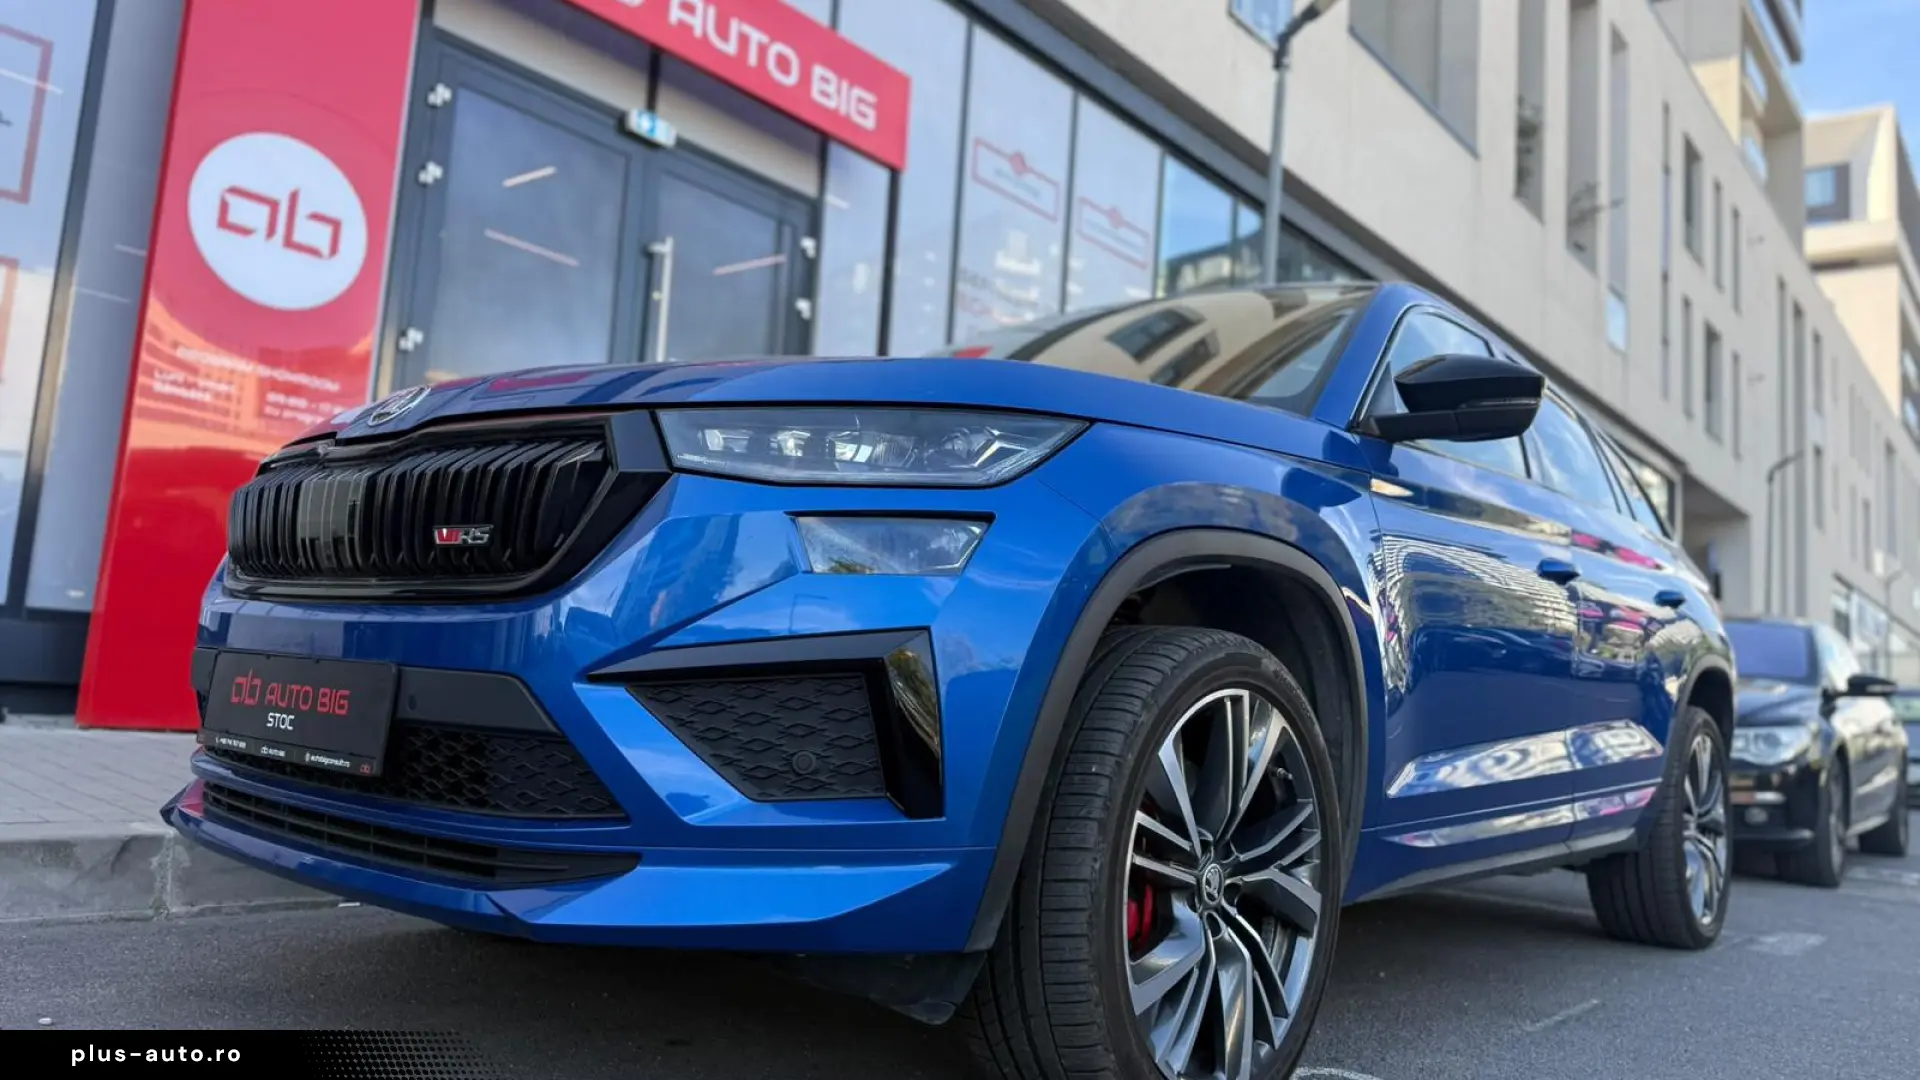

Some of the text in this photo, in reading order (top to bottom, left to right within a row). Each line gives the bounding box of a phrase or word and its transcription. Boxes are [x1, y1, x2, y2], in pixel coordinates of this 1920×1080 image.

[668, 0, 878, 132] AUTO BIG
[264, 682, 314, 711] AUTO
[317, 687, 352, 716] BIG
[266, 712, 295, 731] STOC
